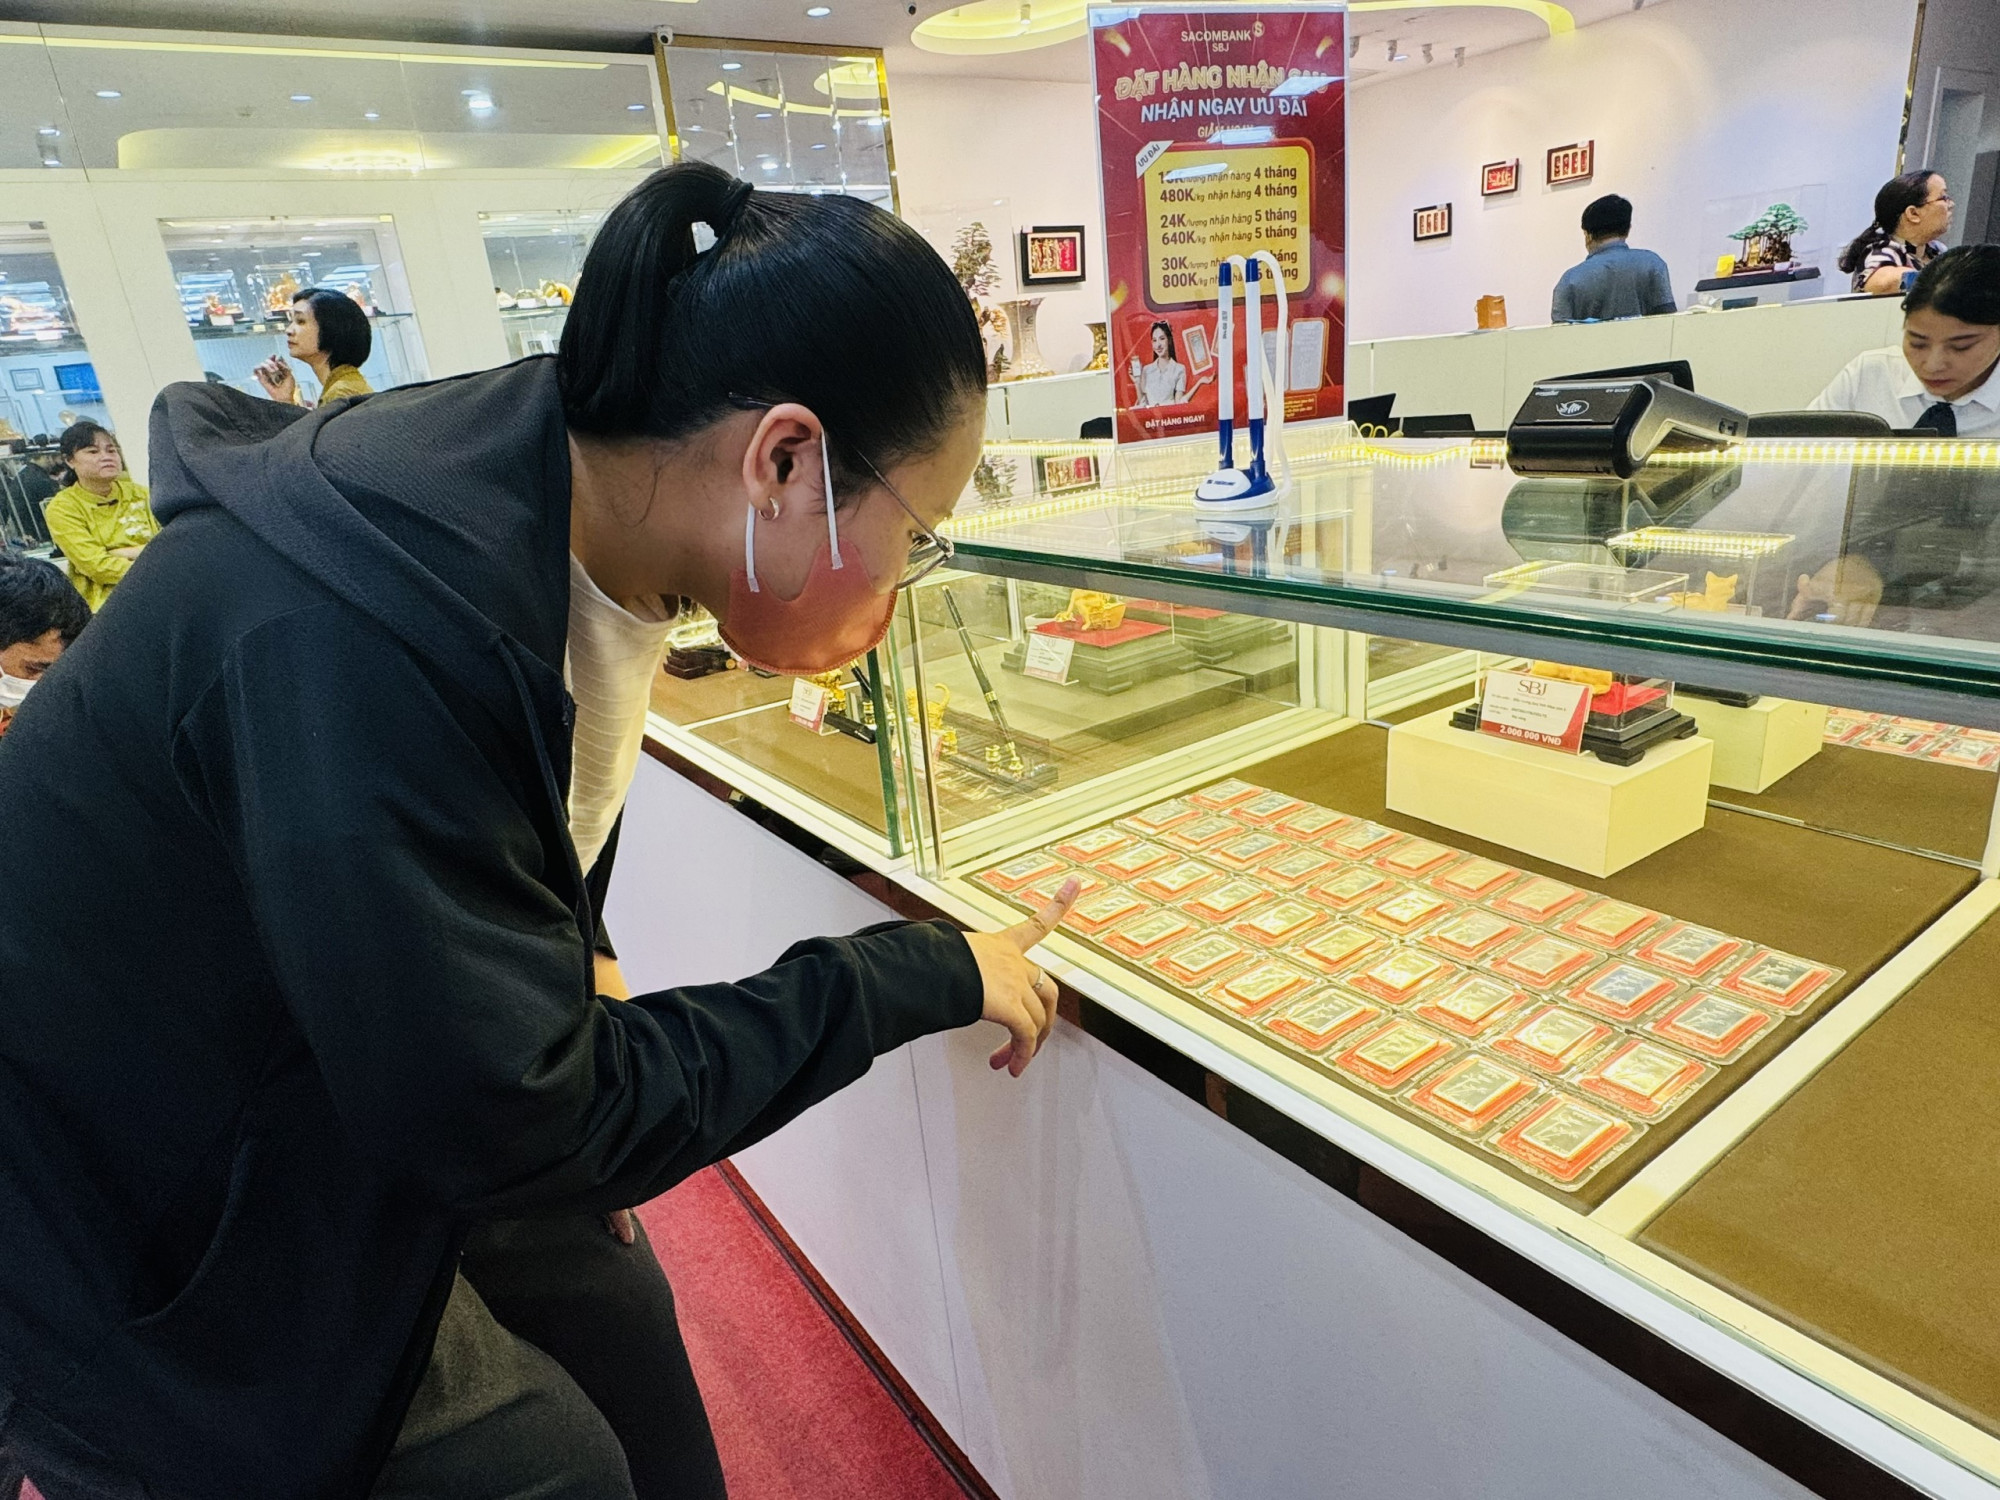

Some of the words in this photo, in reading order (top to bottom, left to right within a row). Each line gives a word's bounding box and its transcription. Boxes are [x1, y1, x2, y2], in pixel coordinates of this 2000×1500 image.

[1181, 30, 1251, 42] SACOMBANK
[1212, 43, 1230, 52] SBJ
[1115, 68, 1160, 101] ĐẶT
[1162, 61, 1222, 93] HÀNG
[1226, 59, 1285, 93] NHẬN
[1141, 97, 1193, 123] NHẬN
[1198, 97, 1246, 117] NGAY
[1250, 96, 1275, 115] ƯU
[1278, 96, 1307, 116] ĐÃI
[1254, 167, 1261, 179] 4
[1264, 165, 1297, 180] tháng
[1208, 190, 1229, 201] nhận
[1231, 188, 1251, 200] hàng
[1254, 184, 1262, 197] 4
[1264, 182, 1297, 198] tháng
[1209, 214, 1230, 226] nhận
[1232, 212, 1252, 225] hàng
[1255, 209, 1262, 222] 5
[1265, 207, 1297, 223] tháng
[1209, 232, 1230, 243] nhận
[1232, 230, 1252, 242] hàng
[1255, 226, 1262, 239] 5
[1265, 224, 1297, 240] tháng
[1145, 418, 1160, 429] ĐẶT
[1161, 416, 1182, 426] HÀNG
[1183, 414, 1205, 424] NGAY!
[1517, 680, 1548, 696] SBJ
[1500, 725, 1540, 741] 2.000.000
